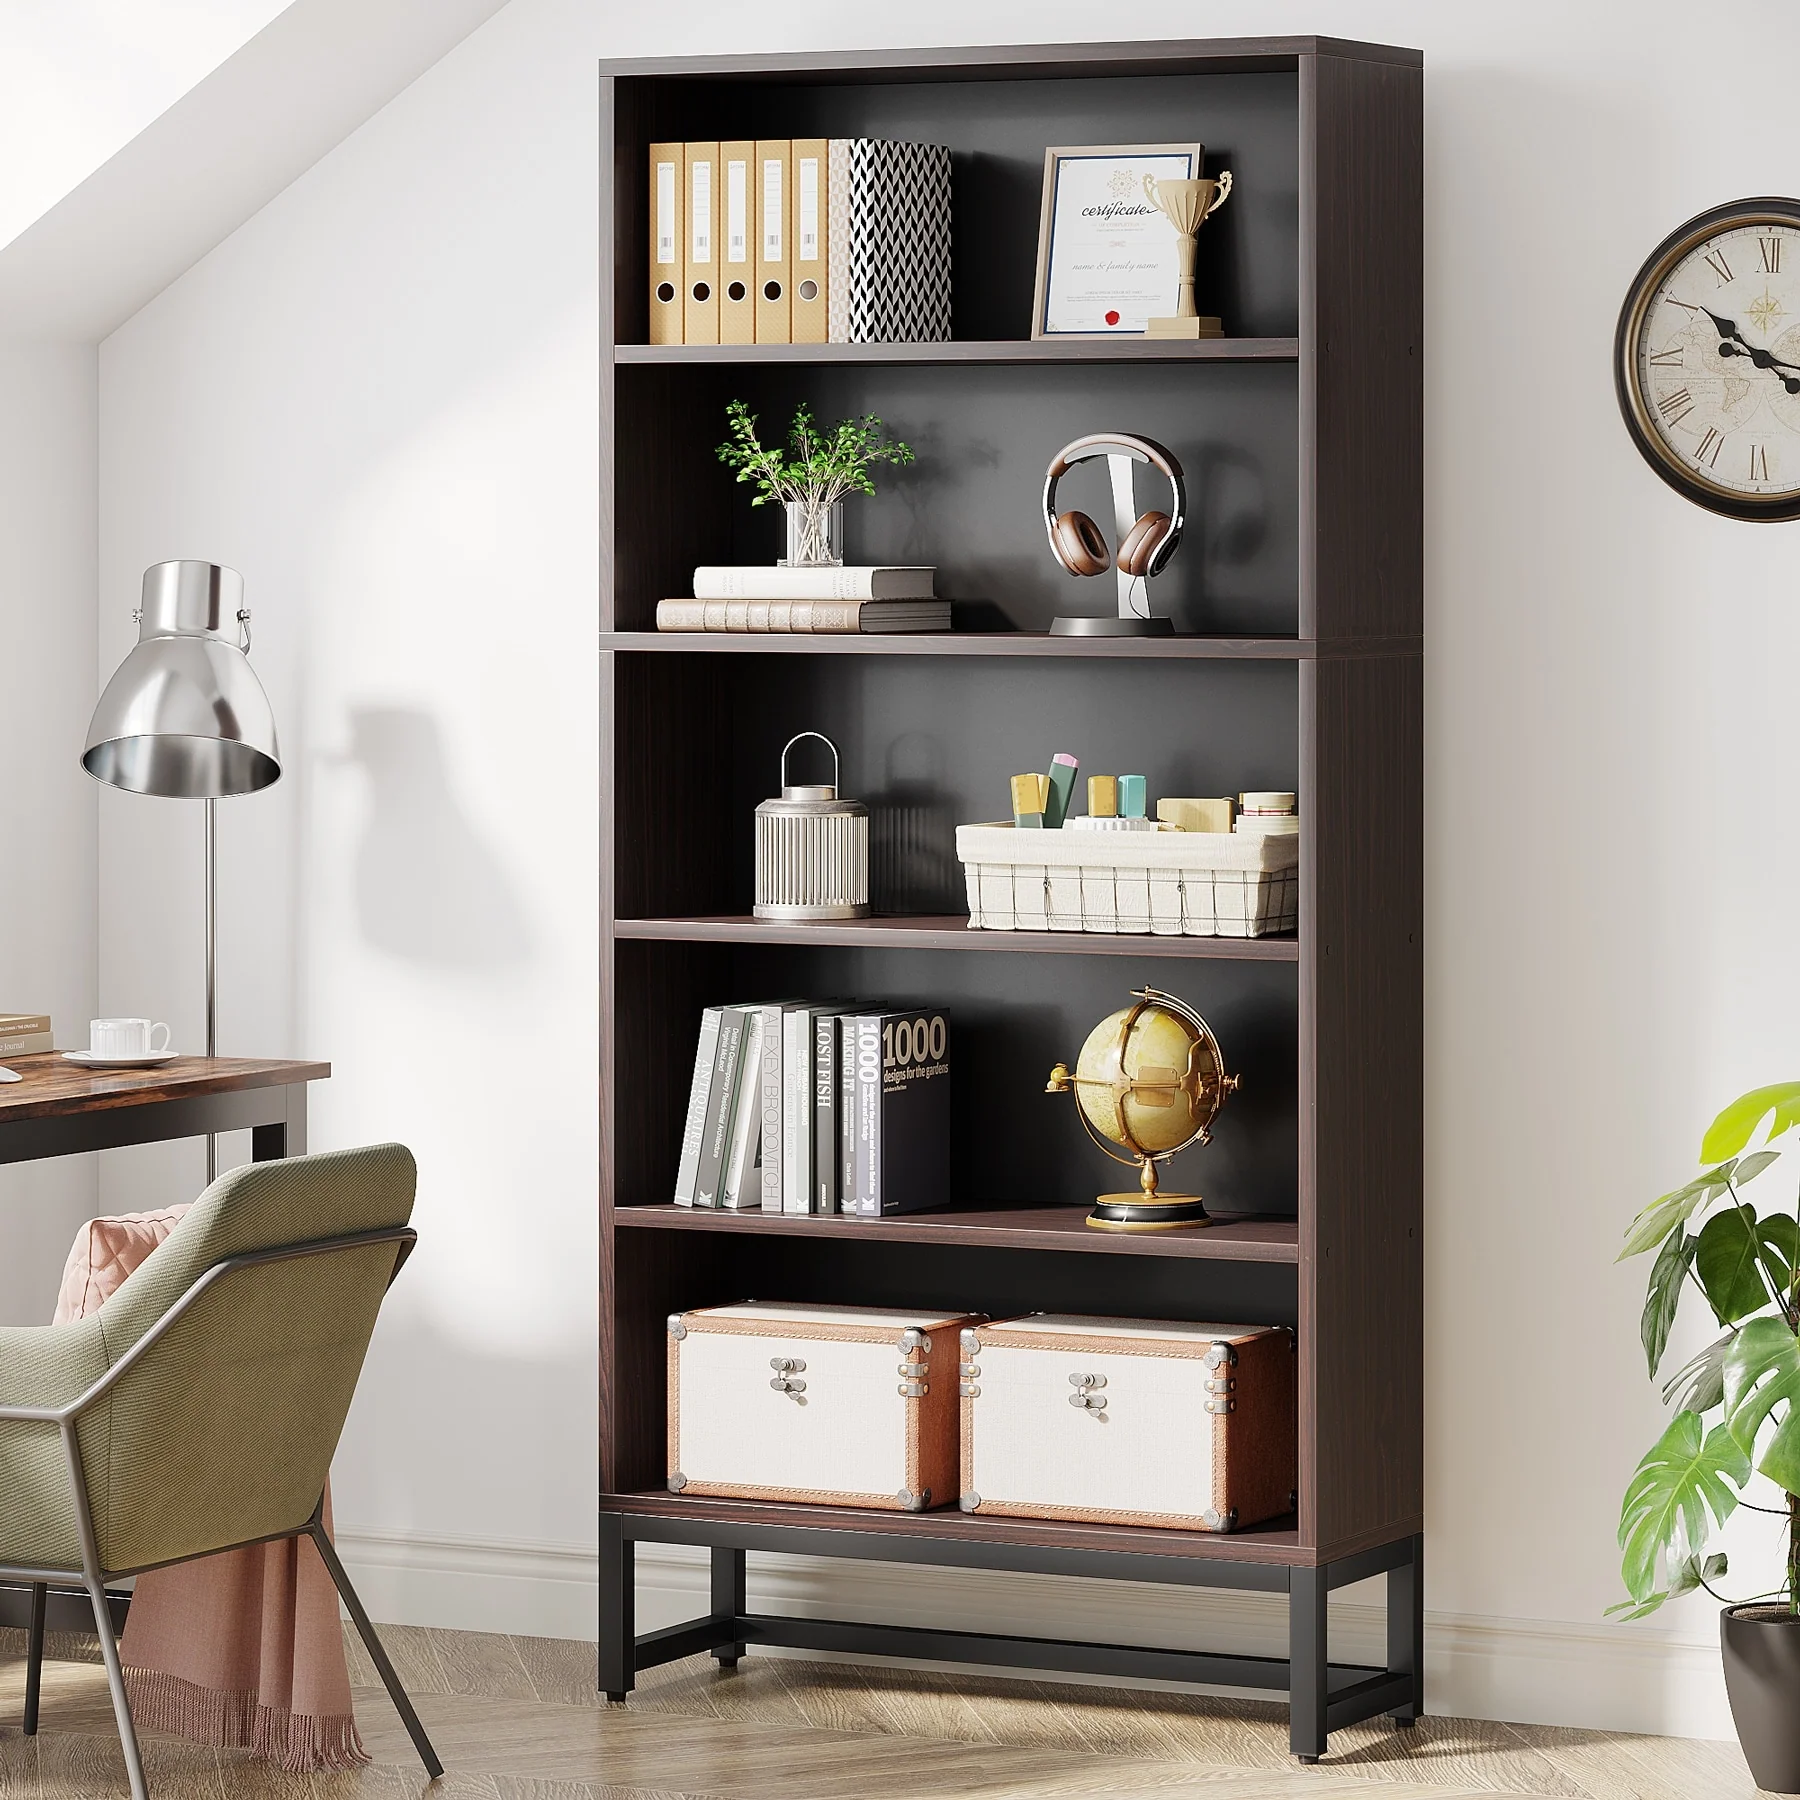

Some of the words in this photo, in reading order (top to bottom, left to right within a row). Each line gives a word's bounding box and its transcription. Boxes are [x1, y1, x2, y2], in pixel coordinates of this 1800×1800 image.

[1082, 201, 1158, 221] certificate
[1097, 261, 1106, 270] &
[1105, 260, 1134, 272] family
[1136, 262, 1159, 270] name
[1702, 248, 1736, 289] XI
[1755, 238, 1782, 273] XII
[1650, 346, 1684, 368] IX
[4, 1041, 25, 1052] Journal
[721, 1026, 731, 1048] Virginia
[731, 1028, 740, 1045] Detail
[764, 1012, 779, 1080] ALEXEY
[817, 1022, 832, 1066] LOST
[843, 1026, 855, 1076] MAKING
[859, 1023, 879, 1083] 1000
[882, 1016, 946, 1068] 1000
[718, 1048, 728, 1072] McLeod
[722, 1051, 736, 1092] Contemporary
[883, 1069, 906, 1084] designs
[906, 1066, 915, 1080] for
[915, 1064, 925, 1078] the
[925, 1062, 949, 1079] gardens
[817, 1069, 832, 1108] FISH
[843, 1078, 855, 1092] IT
[689, 1059, 712, 1156] ANTIQUAIRES
[719, 1092, 730, 1124] Residential
[713, 1124, 725, 1158] Architecture
[764, 1086, 779, 1198] BRODOVITCH
[787, 1126, 796, 1158] France
